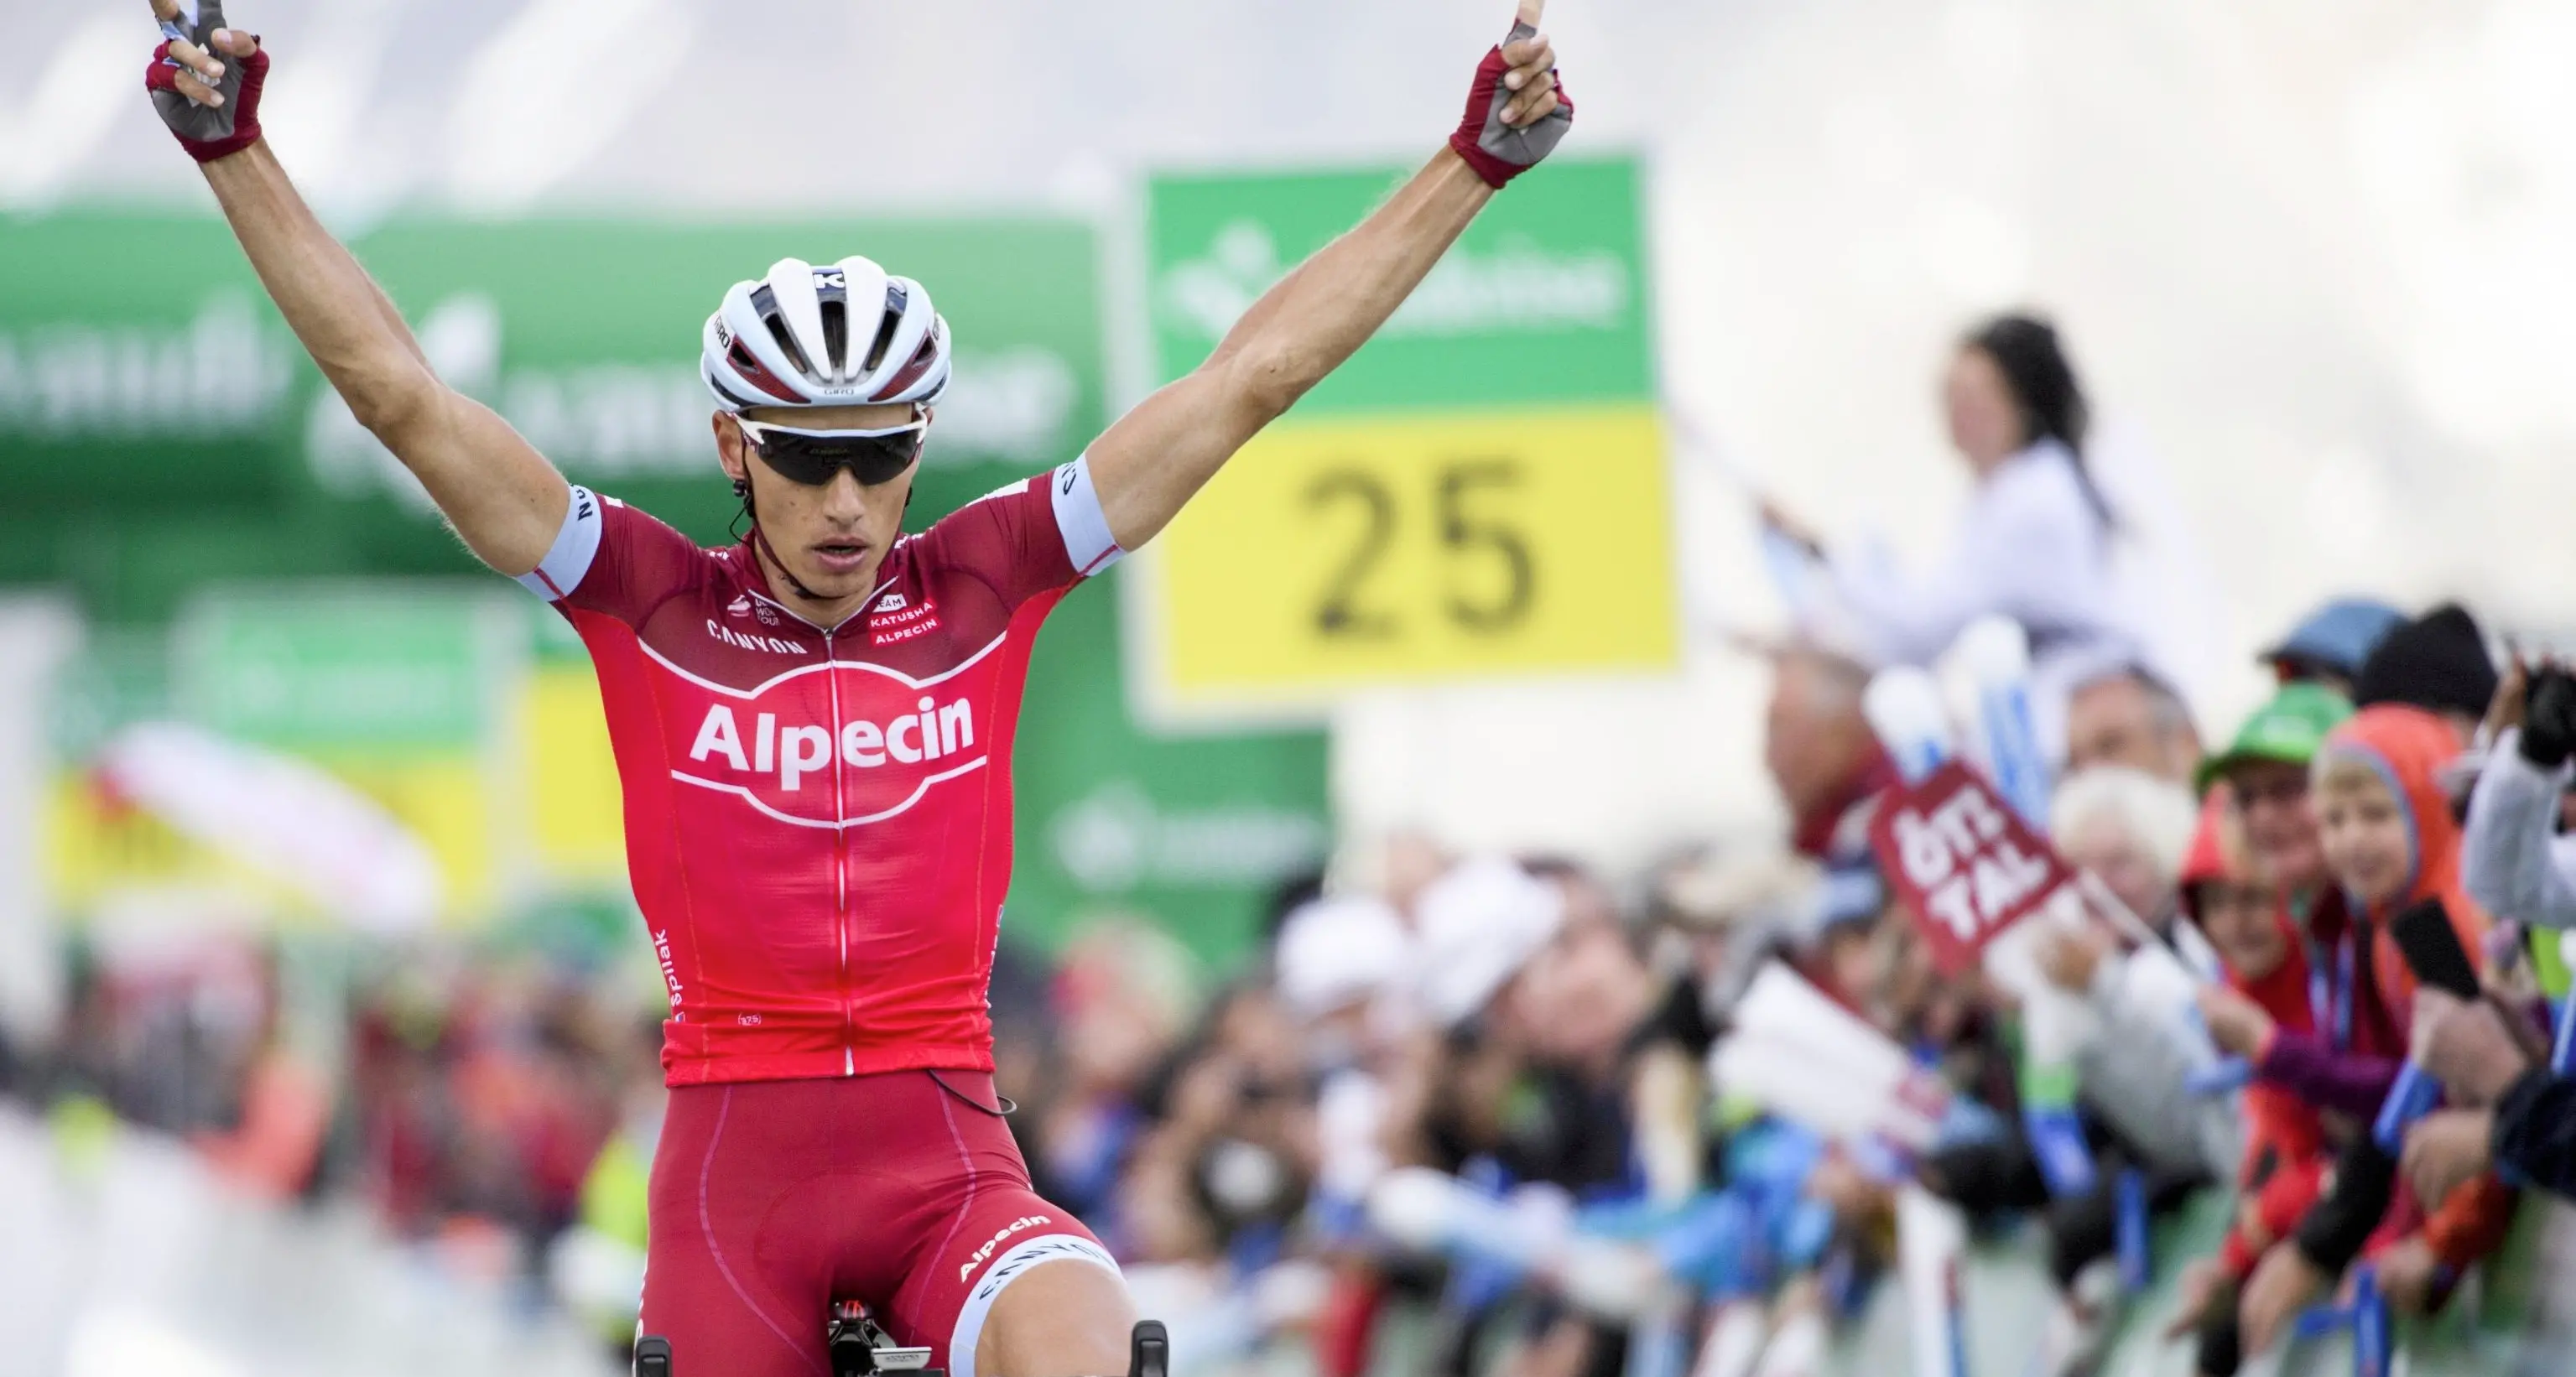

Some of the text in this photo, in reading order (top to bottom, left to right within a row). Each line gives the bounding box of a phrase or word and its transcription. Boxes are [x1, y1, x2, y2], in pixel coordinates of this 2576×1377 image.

[1303, 457, 1537, 640] 25
[870, 602, 933, 627] KATUSHA
[879, 598, 902, 608] EAM
[706, 619, 808, 654] CANYON
[876, 618, 938, 644] ALPECIN
[690, 696, 974, 791] Alpecin
[960, 1214, 1052, 1284] Alpecin
